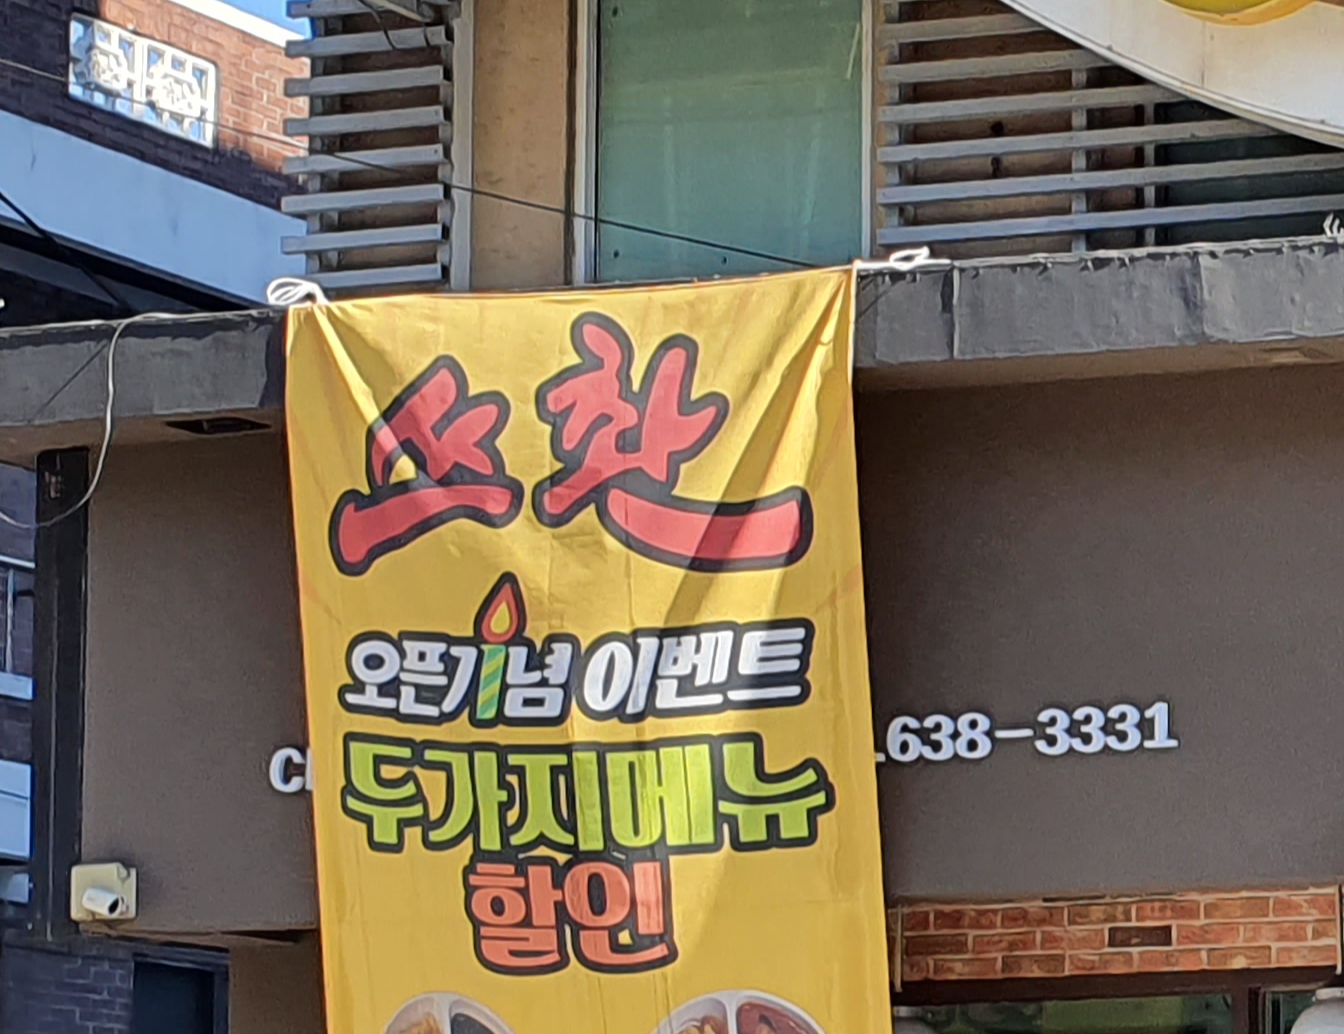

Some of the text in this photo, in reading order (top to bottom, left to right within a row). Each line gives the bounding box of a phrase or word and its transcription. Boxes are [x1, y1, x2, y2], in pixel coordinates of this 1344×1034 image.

[344, 626, 807, 720] 오픈기념 이벤트
[875, 701, 1179, 763] 638-3331
[344, 739, 828, 852] 두가지메뉴
[468, 860, 671, 970] 할인
